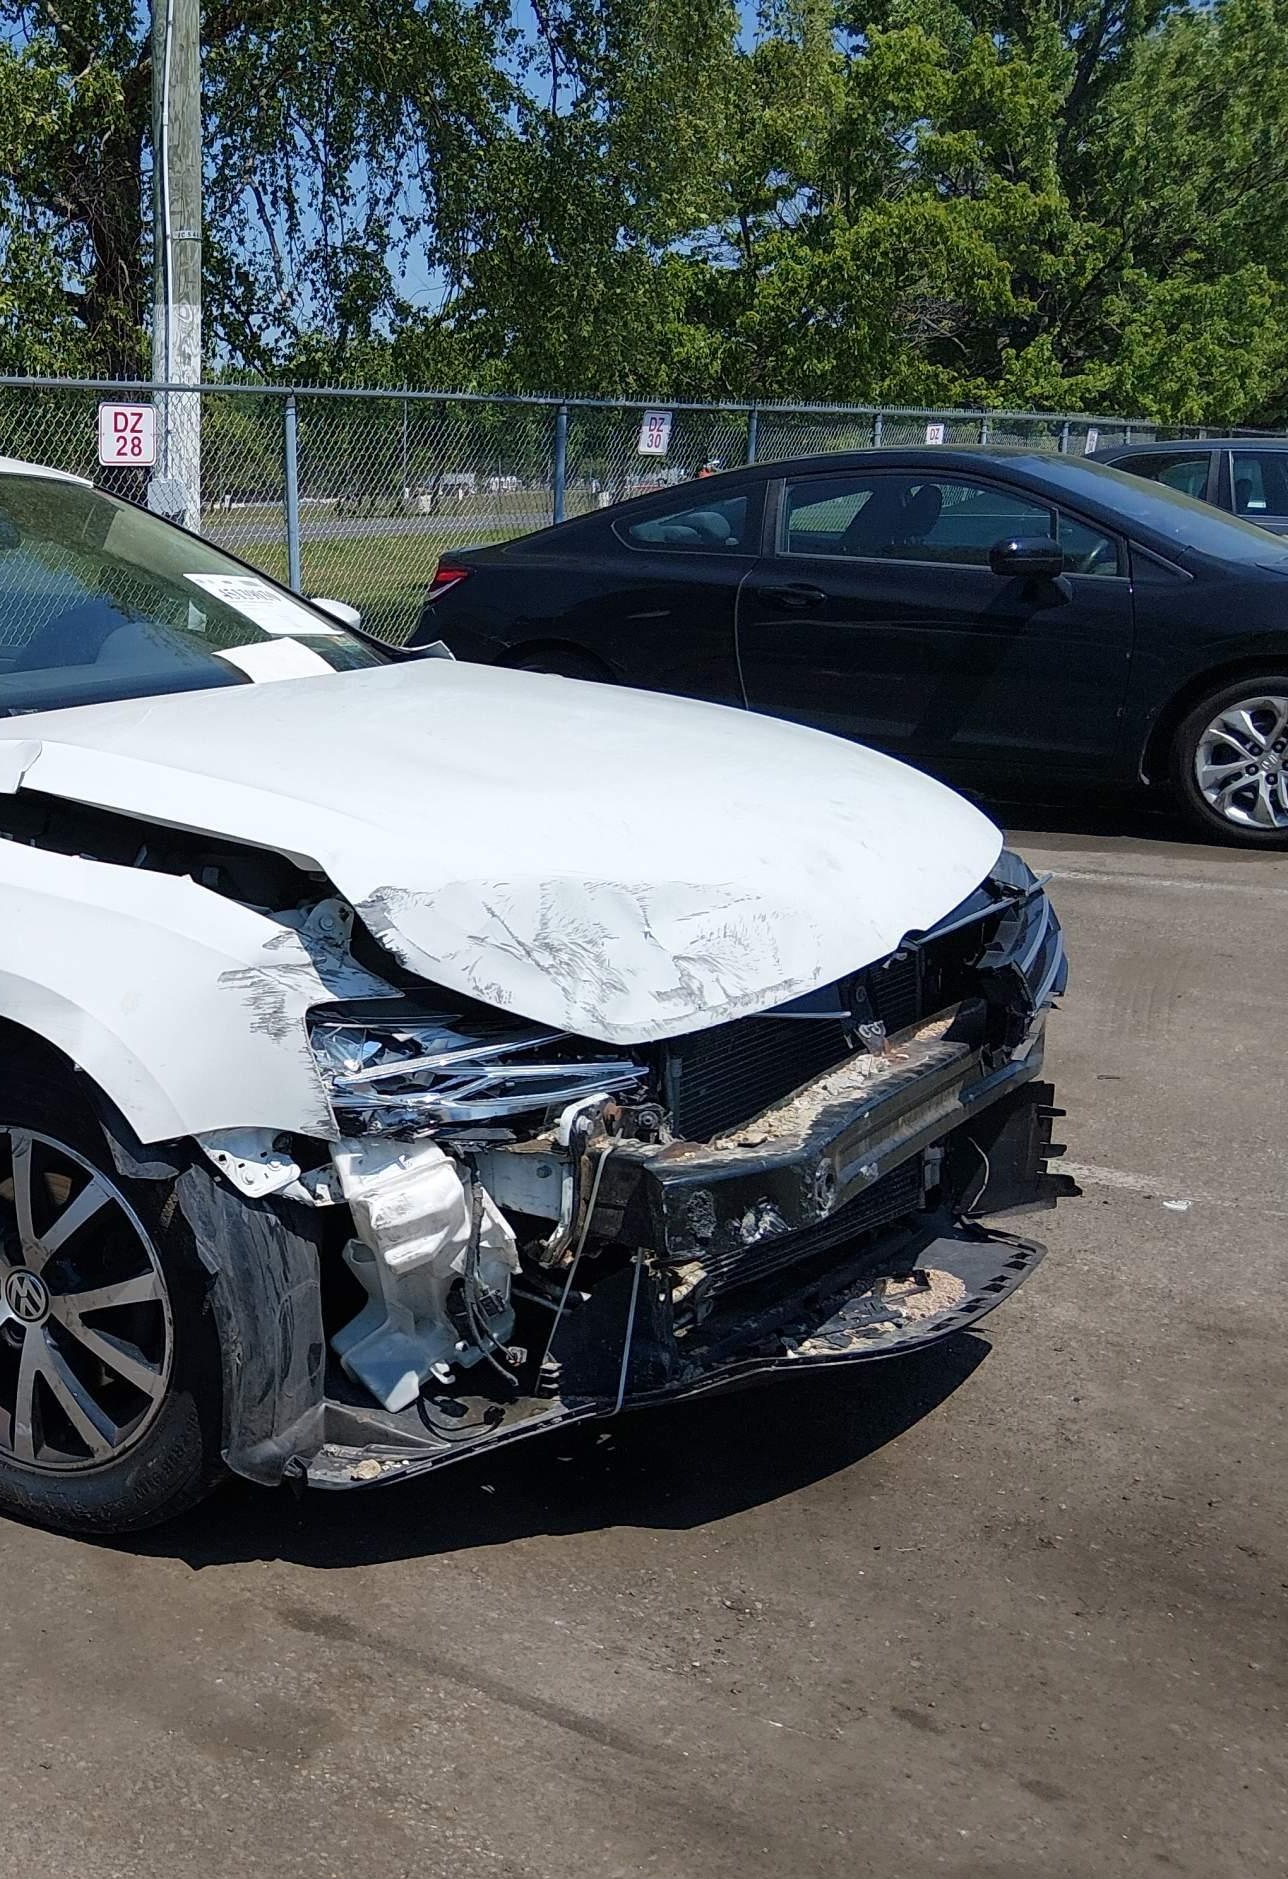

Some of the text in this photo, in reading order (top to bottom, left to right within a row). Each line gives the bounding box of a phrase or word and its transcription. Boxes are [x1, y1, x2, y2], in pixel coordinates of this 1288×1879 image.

[113, 411, 144, 434] DZ
[648, 416, 665, 432] DZ
[115, 435, 143, 457] 28
[647, 433, 662, 448] 30
